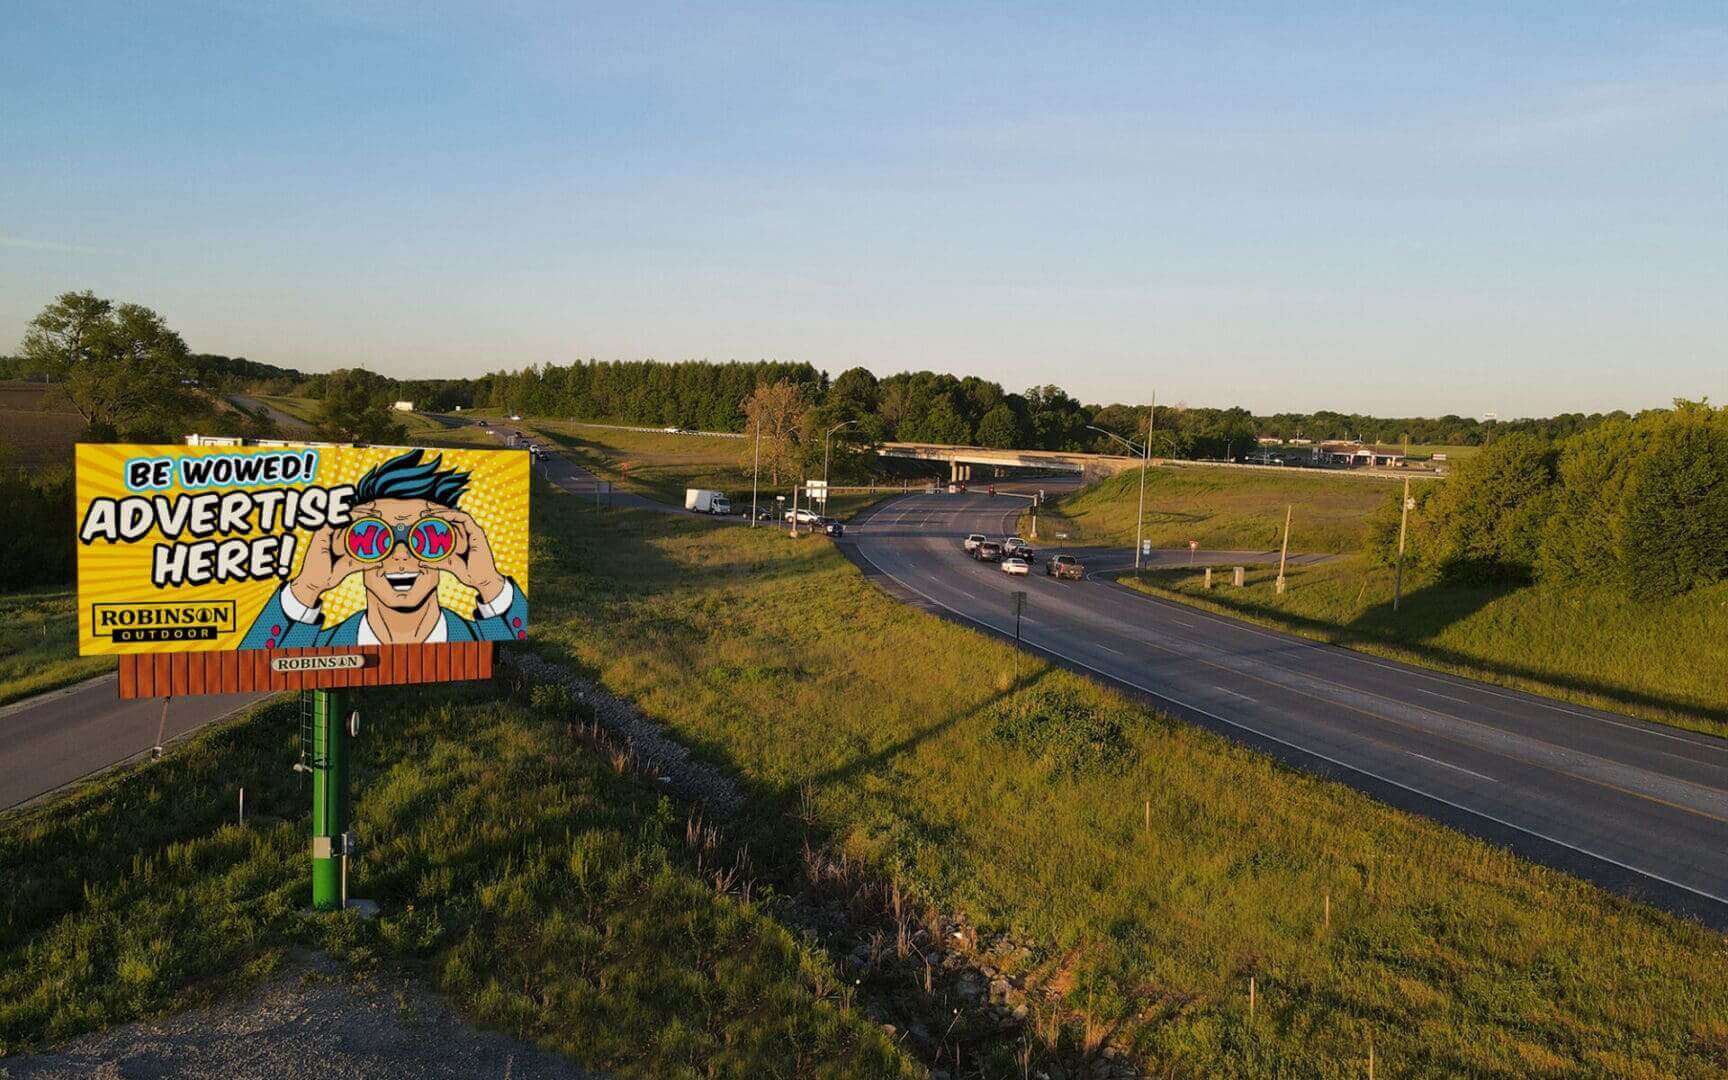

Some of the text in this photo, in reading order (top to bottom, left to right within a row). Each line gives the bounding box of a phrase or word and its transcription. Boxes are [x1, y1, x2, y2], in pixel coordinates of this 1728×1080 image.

[129, 453, 315, 487] BE WOWED!
[80, 485, 355, 542] ADVERTISE
[153, 534, 297, 587] HERE!
[101, 607, 228, 626] ROBINSON
[121, 628, 209, 641] OUTDOOR
